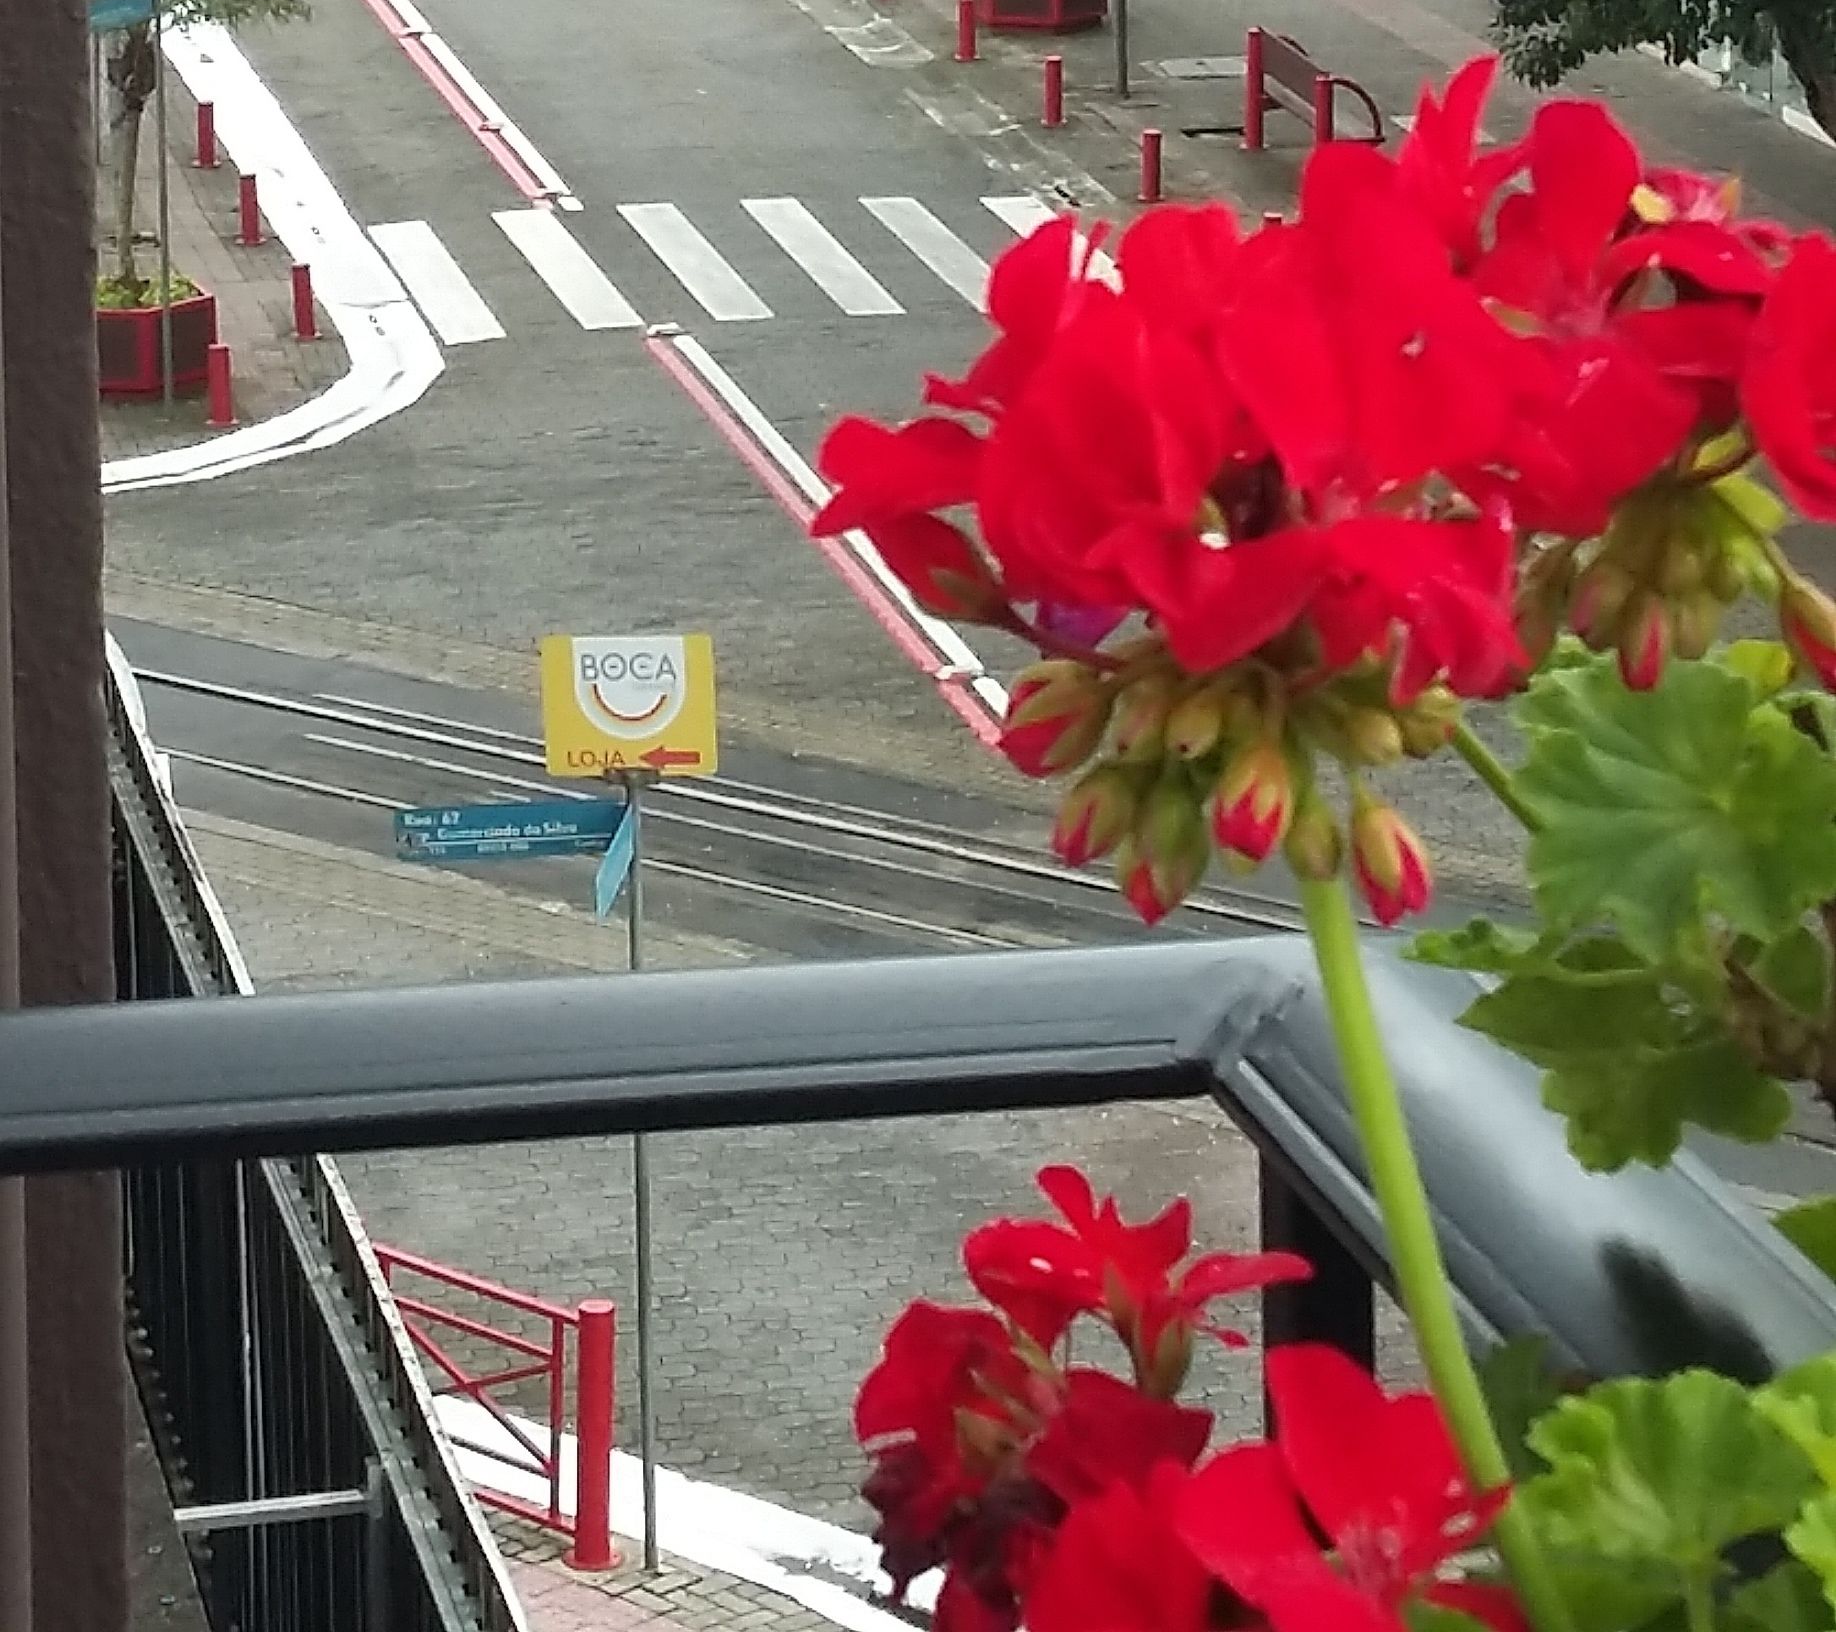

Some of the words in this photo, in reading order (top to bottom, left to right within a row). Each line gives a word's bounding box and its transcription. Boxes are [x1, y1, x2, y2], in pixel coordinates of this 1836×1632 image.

[580, 652, 677, 681] BOCA
[567, 750, 626, 768] LOJA
[442, 811, 459, 825] 67
[523, 824, 542, 836] da
